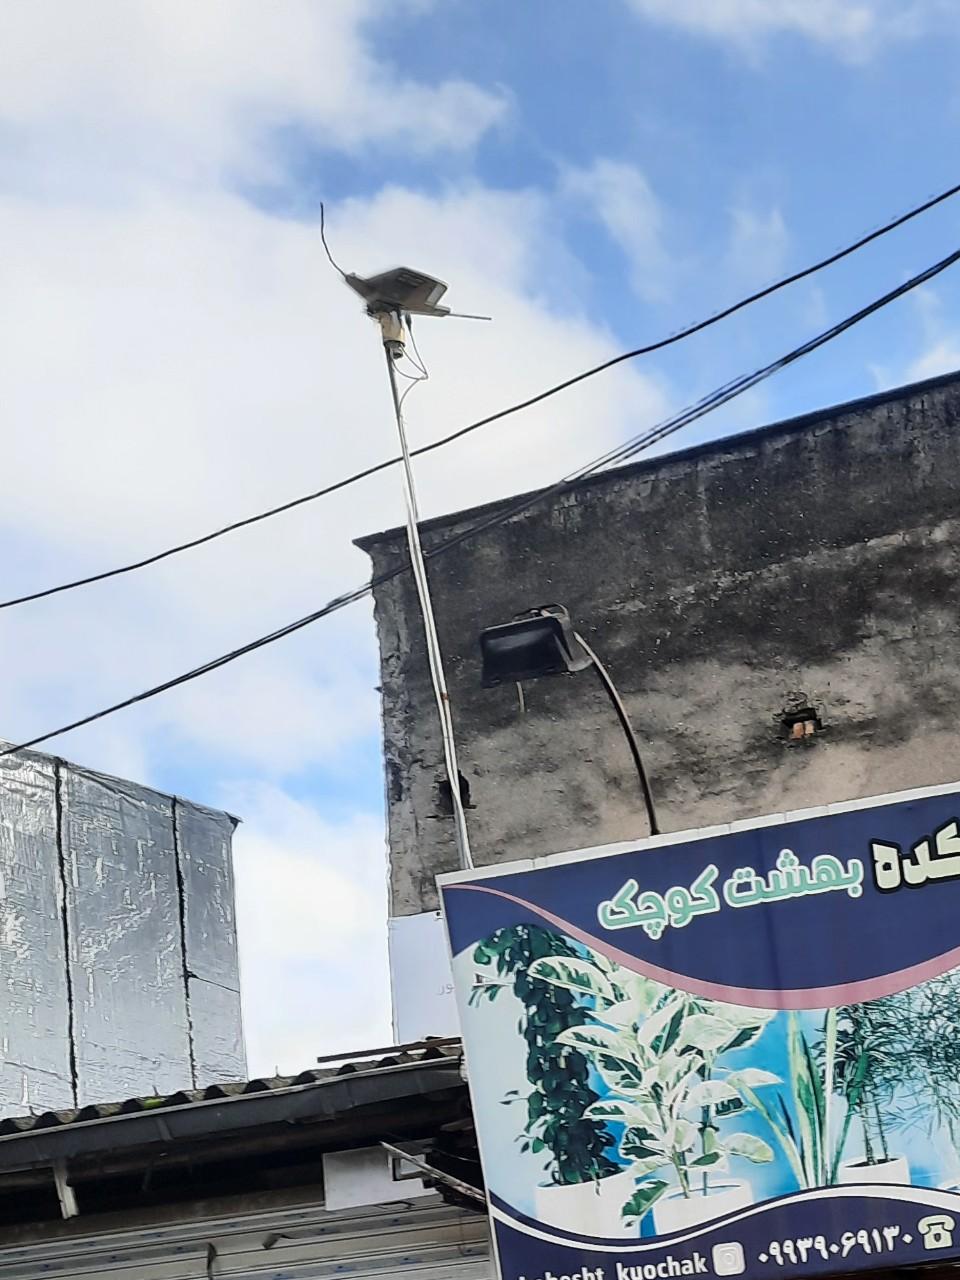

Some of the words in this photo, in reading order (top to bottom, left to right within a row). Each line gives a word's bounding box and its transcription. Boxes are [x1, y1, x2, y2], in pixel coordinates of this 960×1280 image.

[597, 864, 720, 940] کوچک
[723, 848, 864, 907] بهشت
[758, 1225, 913, 1266] ۰۹۹۳۹۰۶۹۱۳۰
